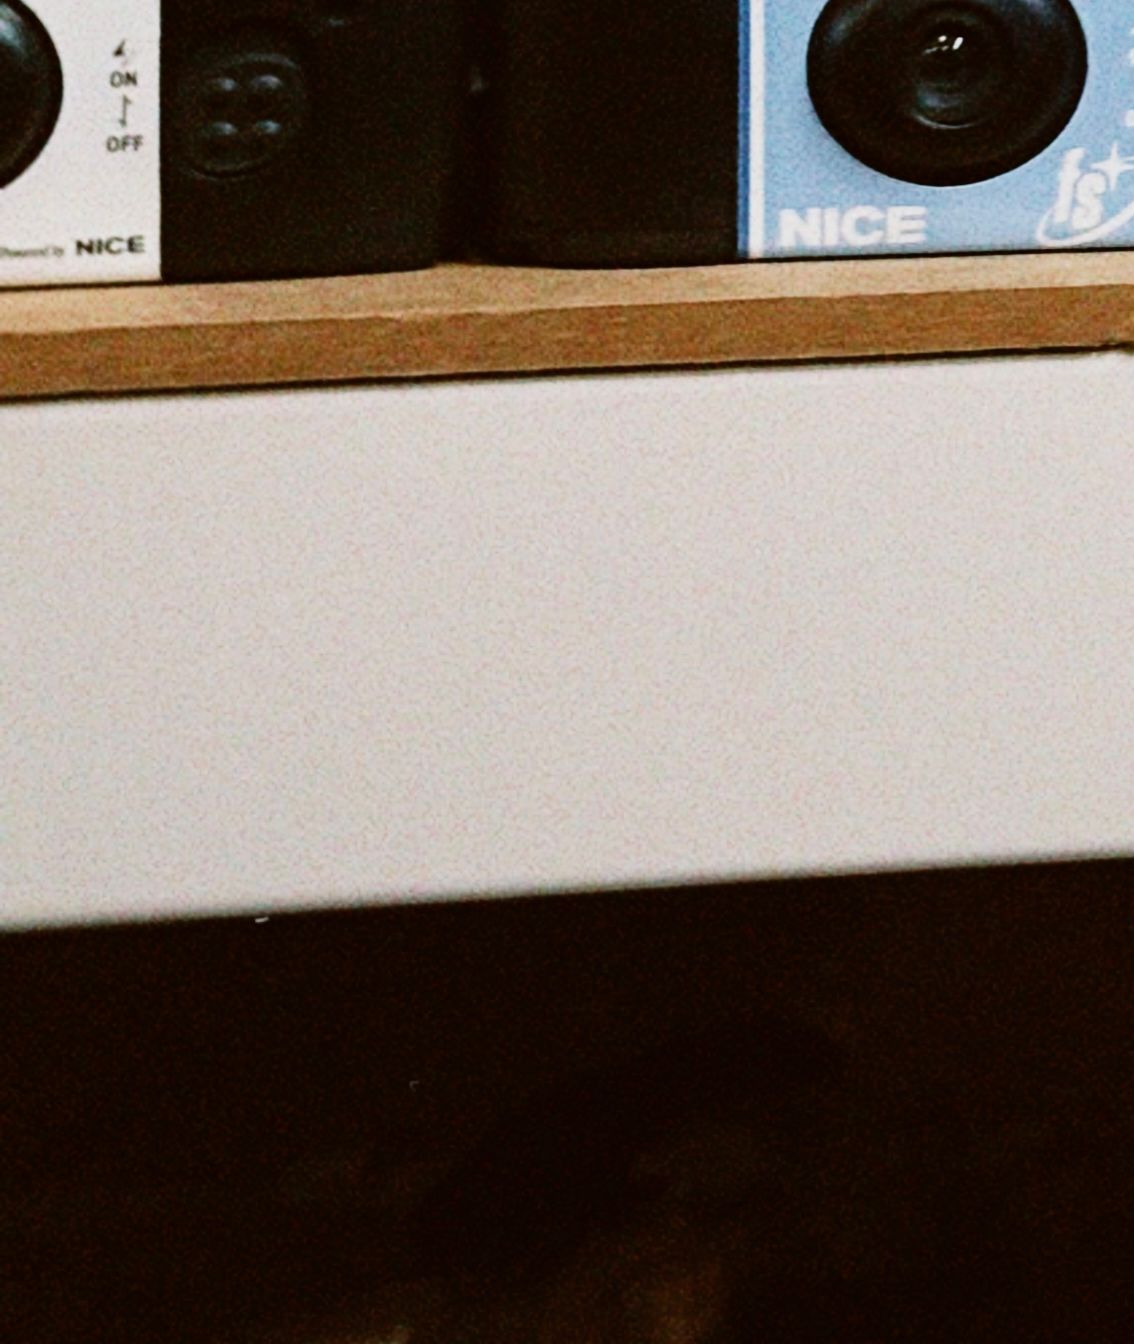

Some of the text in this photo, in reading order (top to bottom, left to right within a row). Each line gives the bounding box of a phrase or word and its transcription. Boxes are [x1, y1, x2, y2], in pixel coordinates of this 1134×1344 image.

[110, 71, 138, 87] ON
[106, 134, 143, 153] OFF
[777, 206, 926, 247] NICE
[75, 234, 146, 256] NICE
